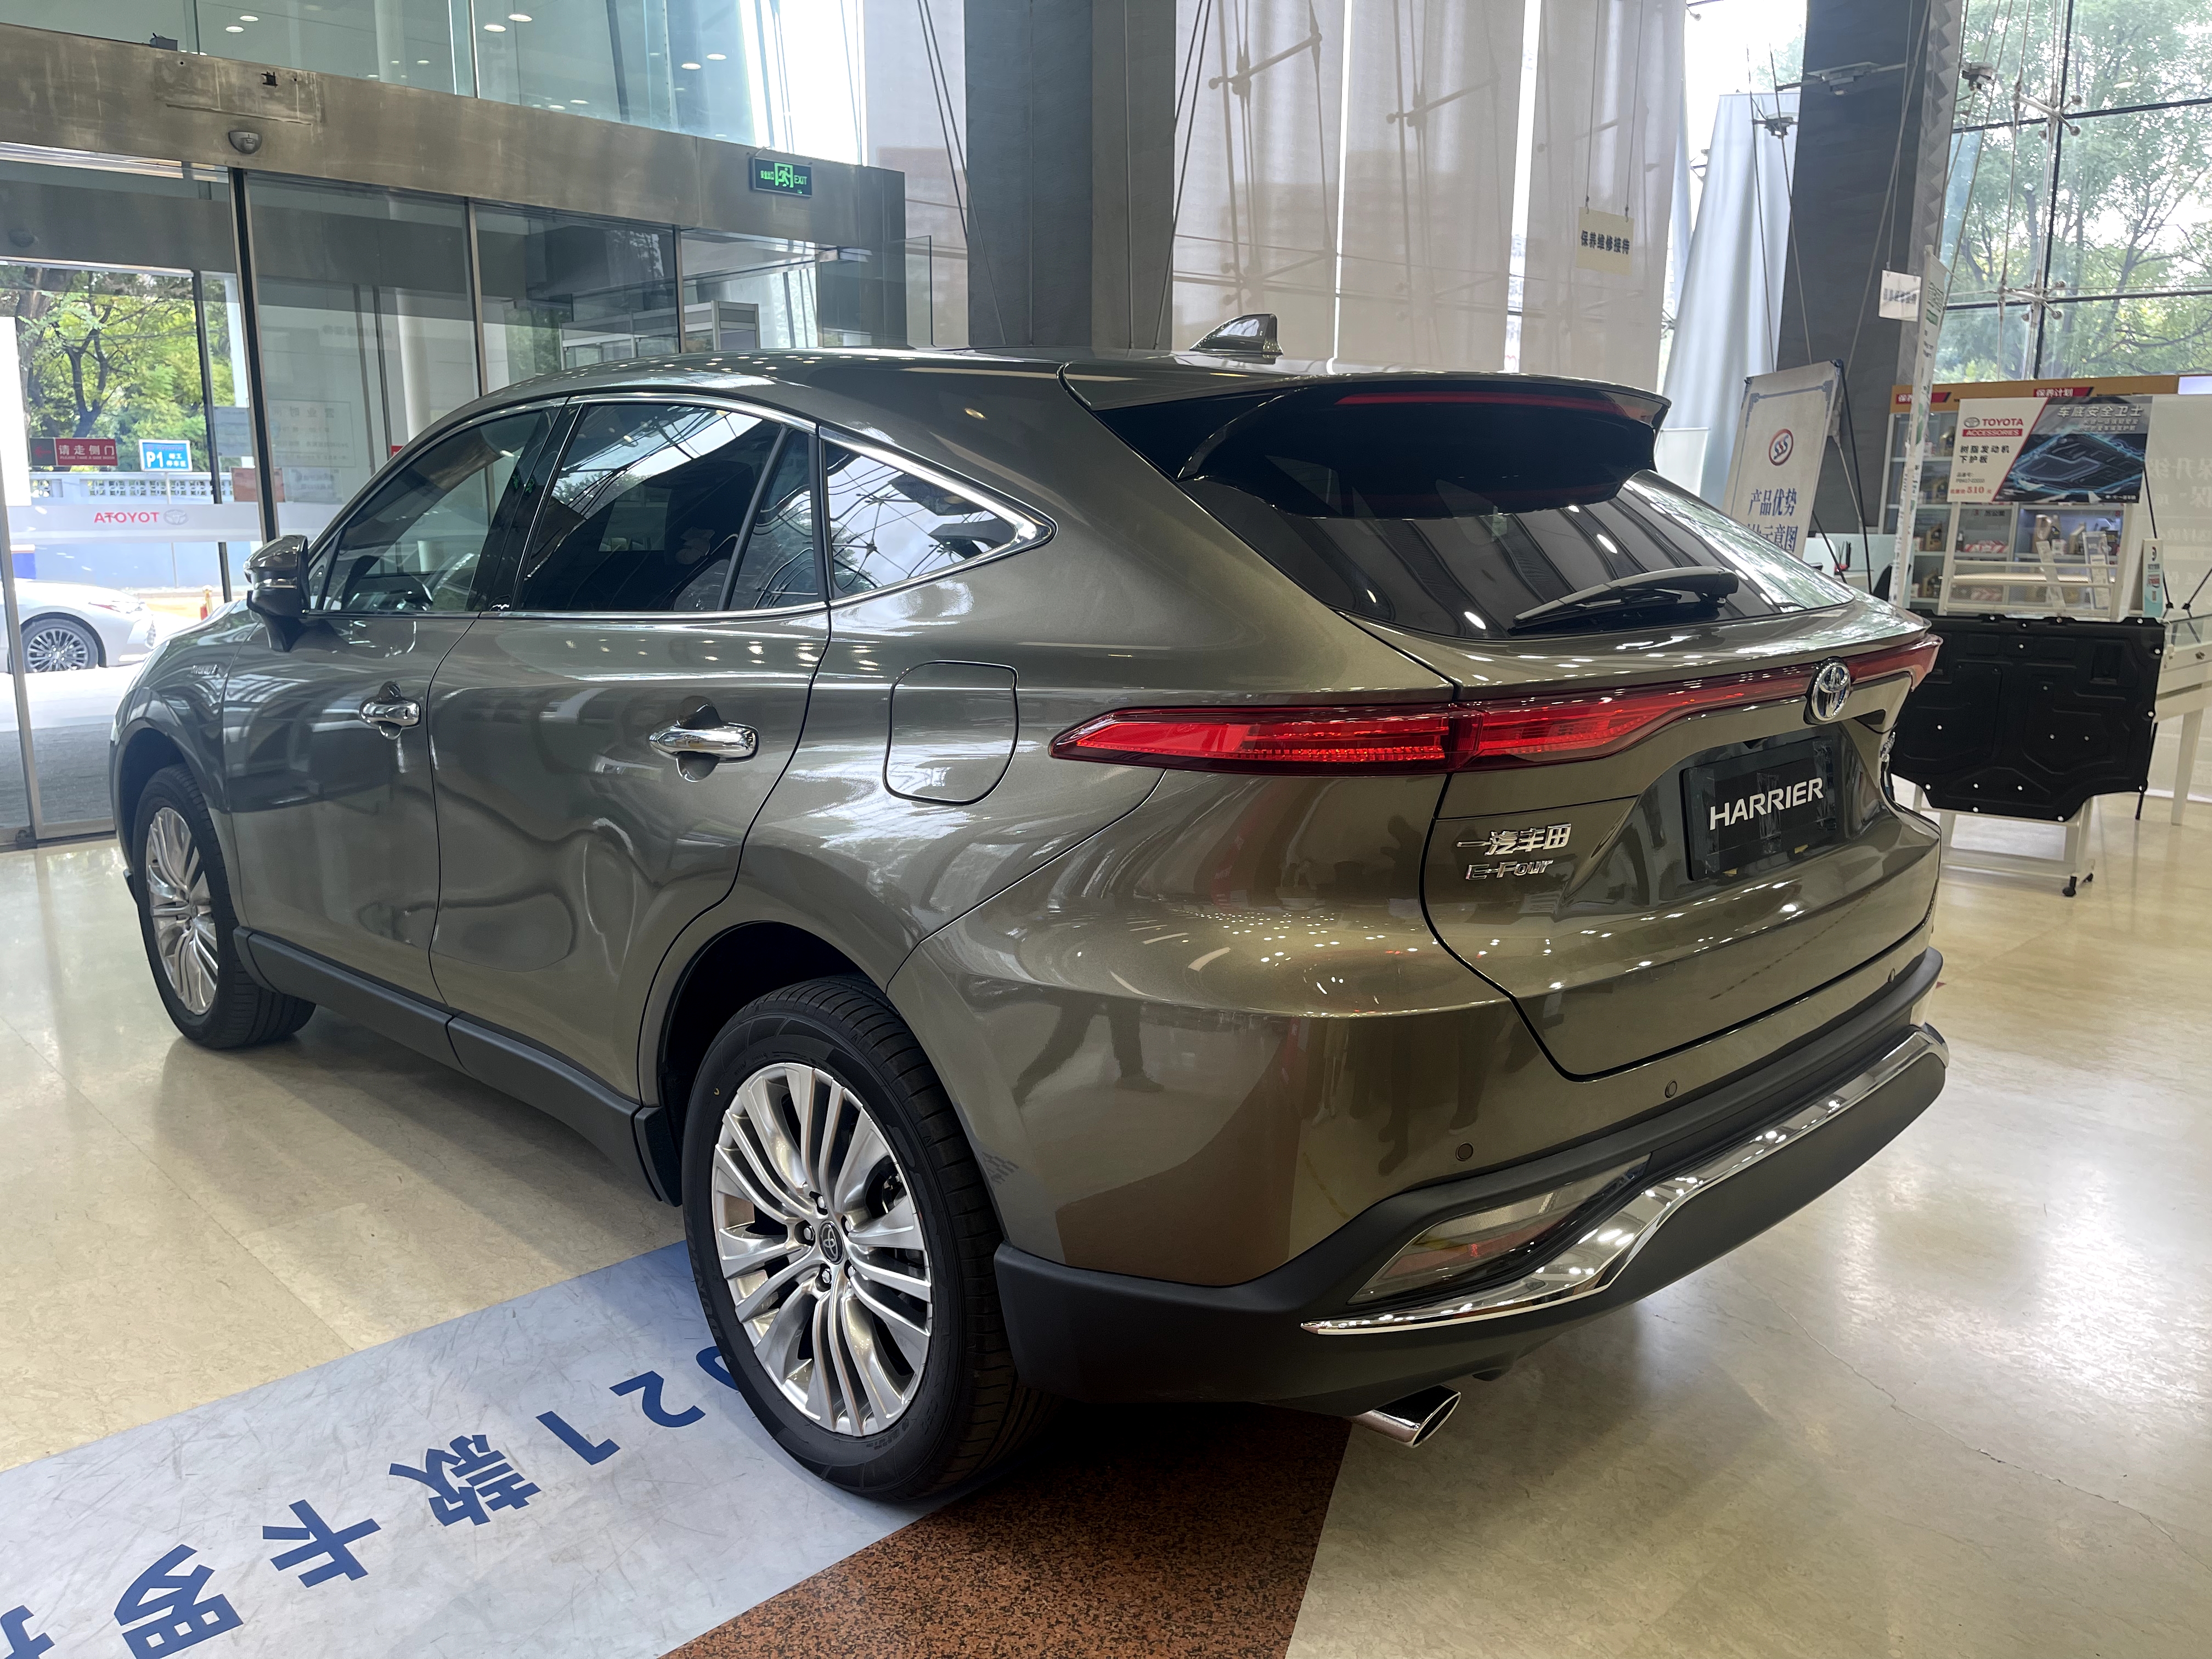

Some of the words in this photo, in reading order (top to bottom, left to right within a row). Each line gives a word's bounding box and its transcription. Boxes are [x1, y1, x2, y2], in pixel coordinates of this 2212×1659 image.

[794, 175, 808, 185] EXIT
[2057, 404, 2144, 418] 车底安全卫士
[1982, 418, 2024, 426] TOYOTA
[58, 445, 115, 456] 请走侧门
[146, 451, 163, 468] P1
[1967, 486, 1985, 494] 510
[1747, 488, 1797, 516] 产品优势
[1709, 777, 1824, 831] HARRIER
[1457, 823, 1572, 856] 一汽丰田
[0, 1345, 738, 1659] 21款卡罗
